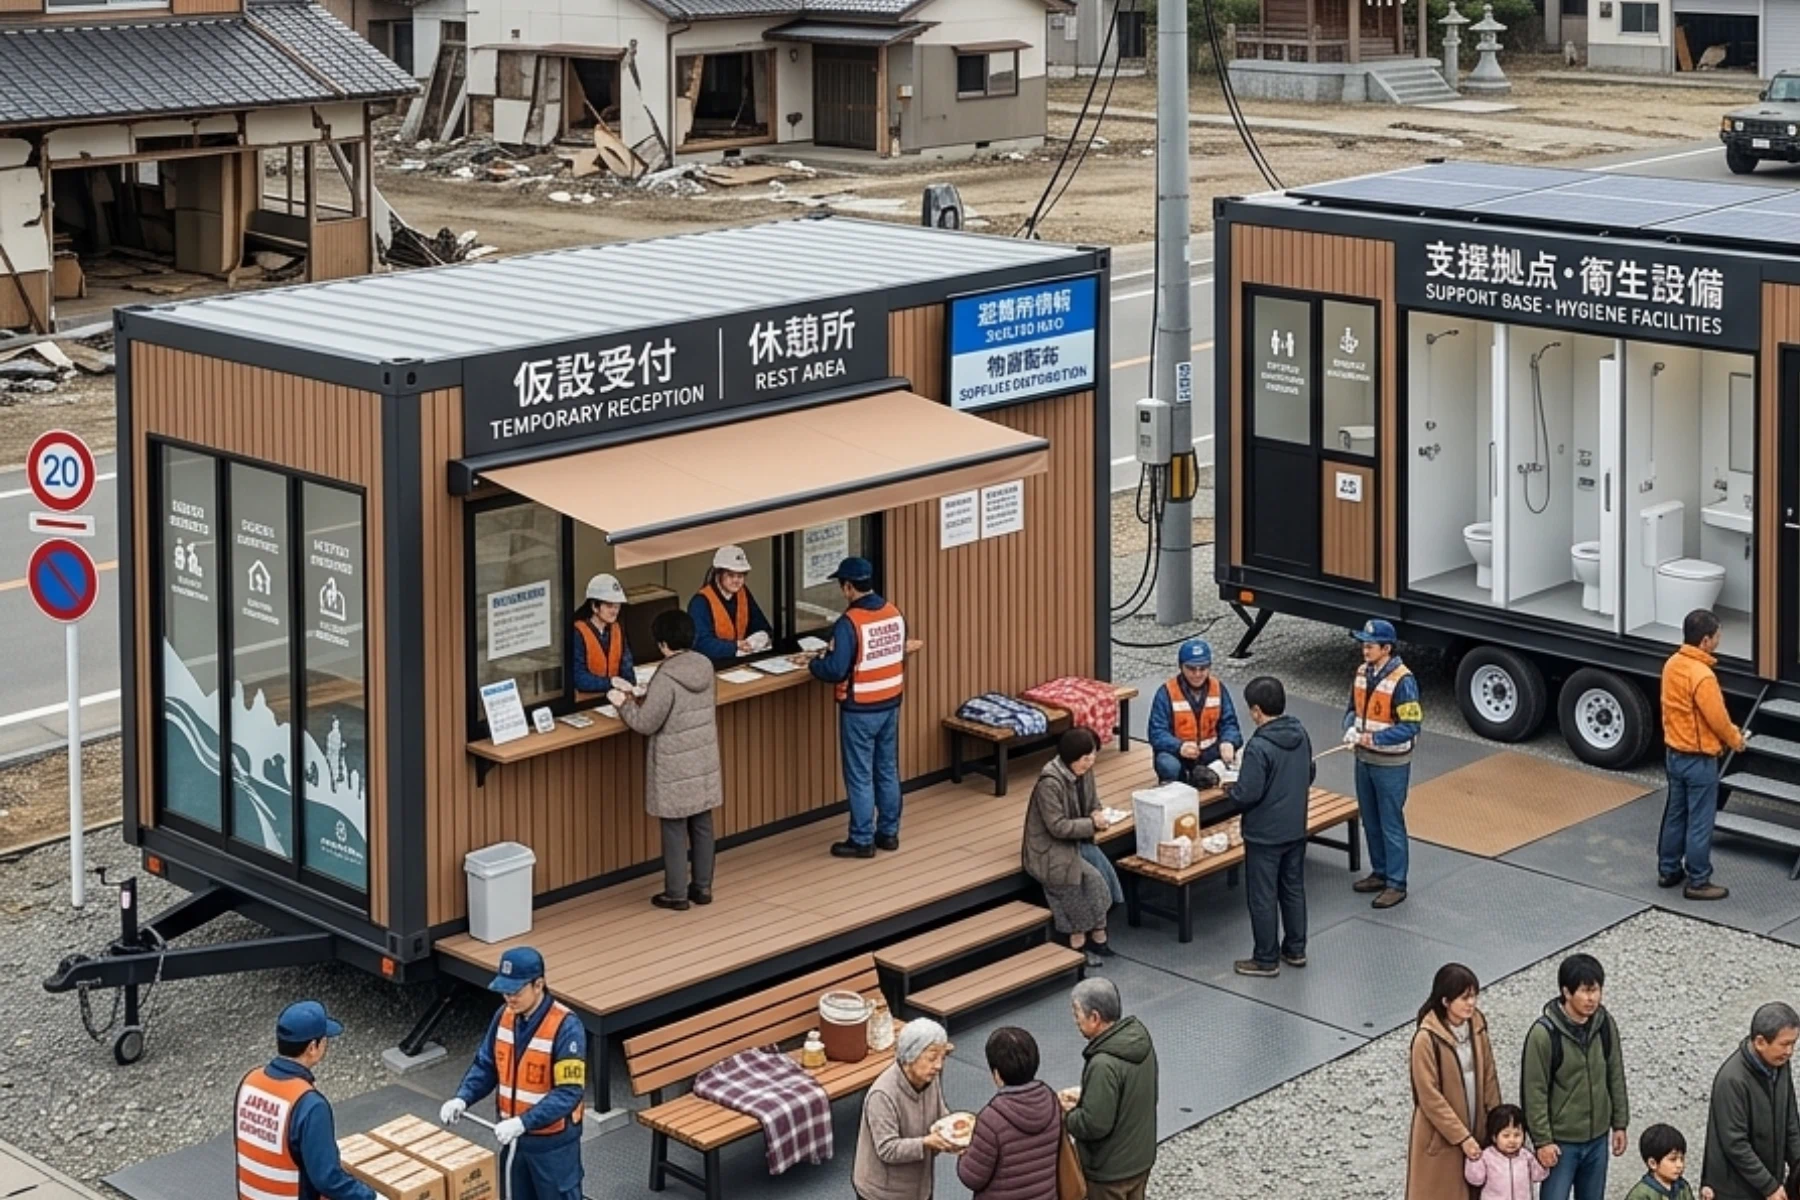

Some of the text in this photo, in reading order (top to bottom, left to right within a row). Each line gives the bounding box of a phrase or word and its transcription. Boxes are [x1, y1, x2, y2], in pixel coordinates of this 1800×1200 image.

[1425, 282, 1498, 306] SUPPORT
[1555, 299, 1628, 324] HYGIENE
[1631, 308, 1723, 336] FACILITIES
[748, 308, 856, 366] 休憩所
[513, 338, 677, 408] 仮設受付
[755, 357, 848, 391] REST AREA
[489, 384, 705, 440] TEMPORARY RECEPTION
[43, 453, 80, 488] 20
